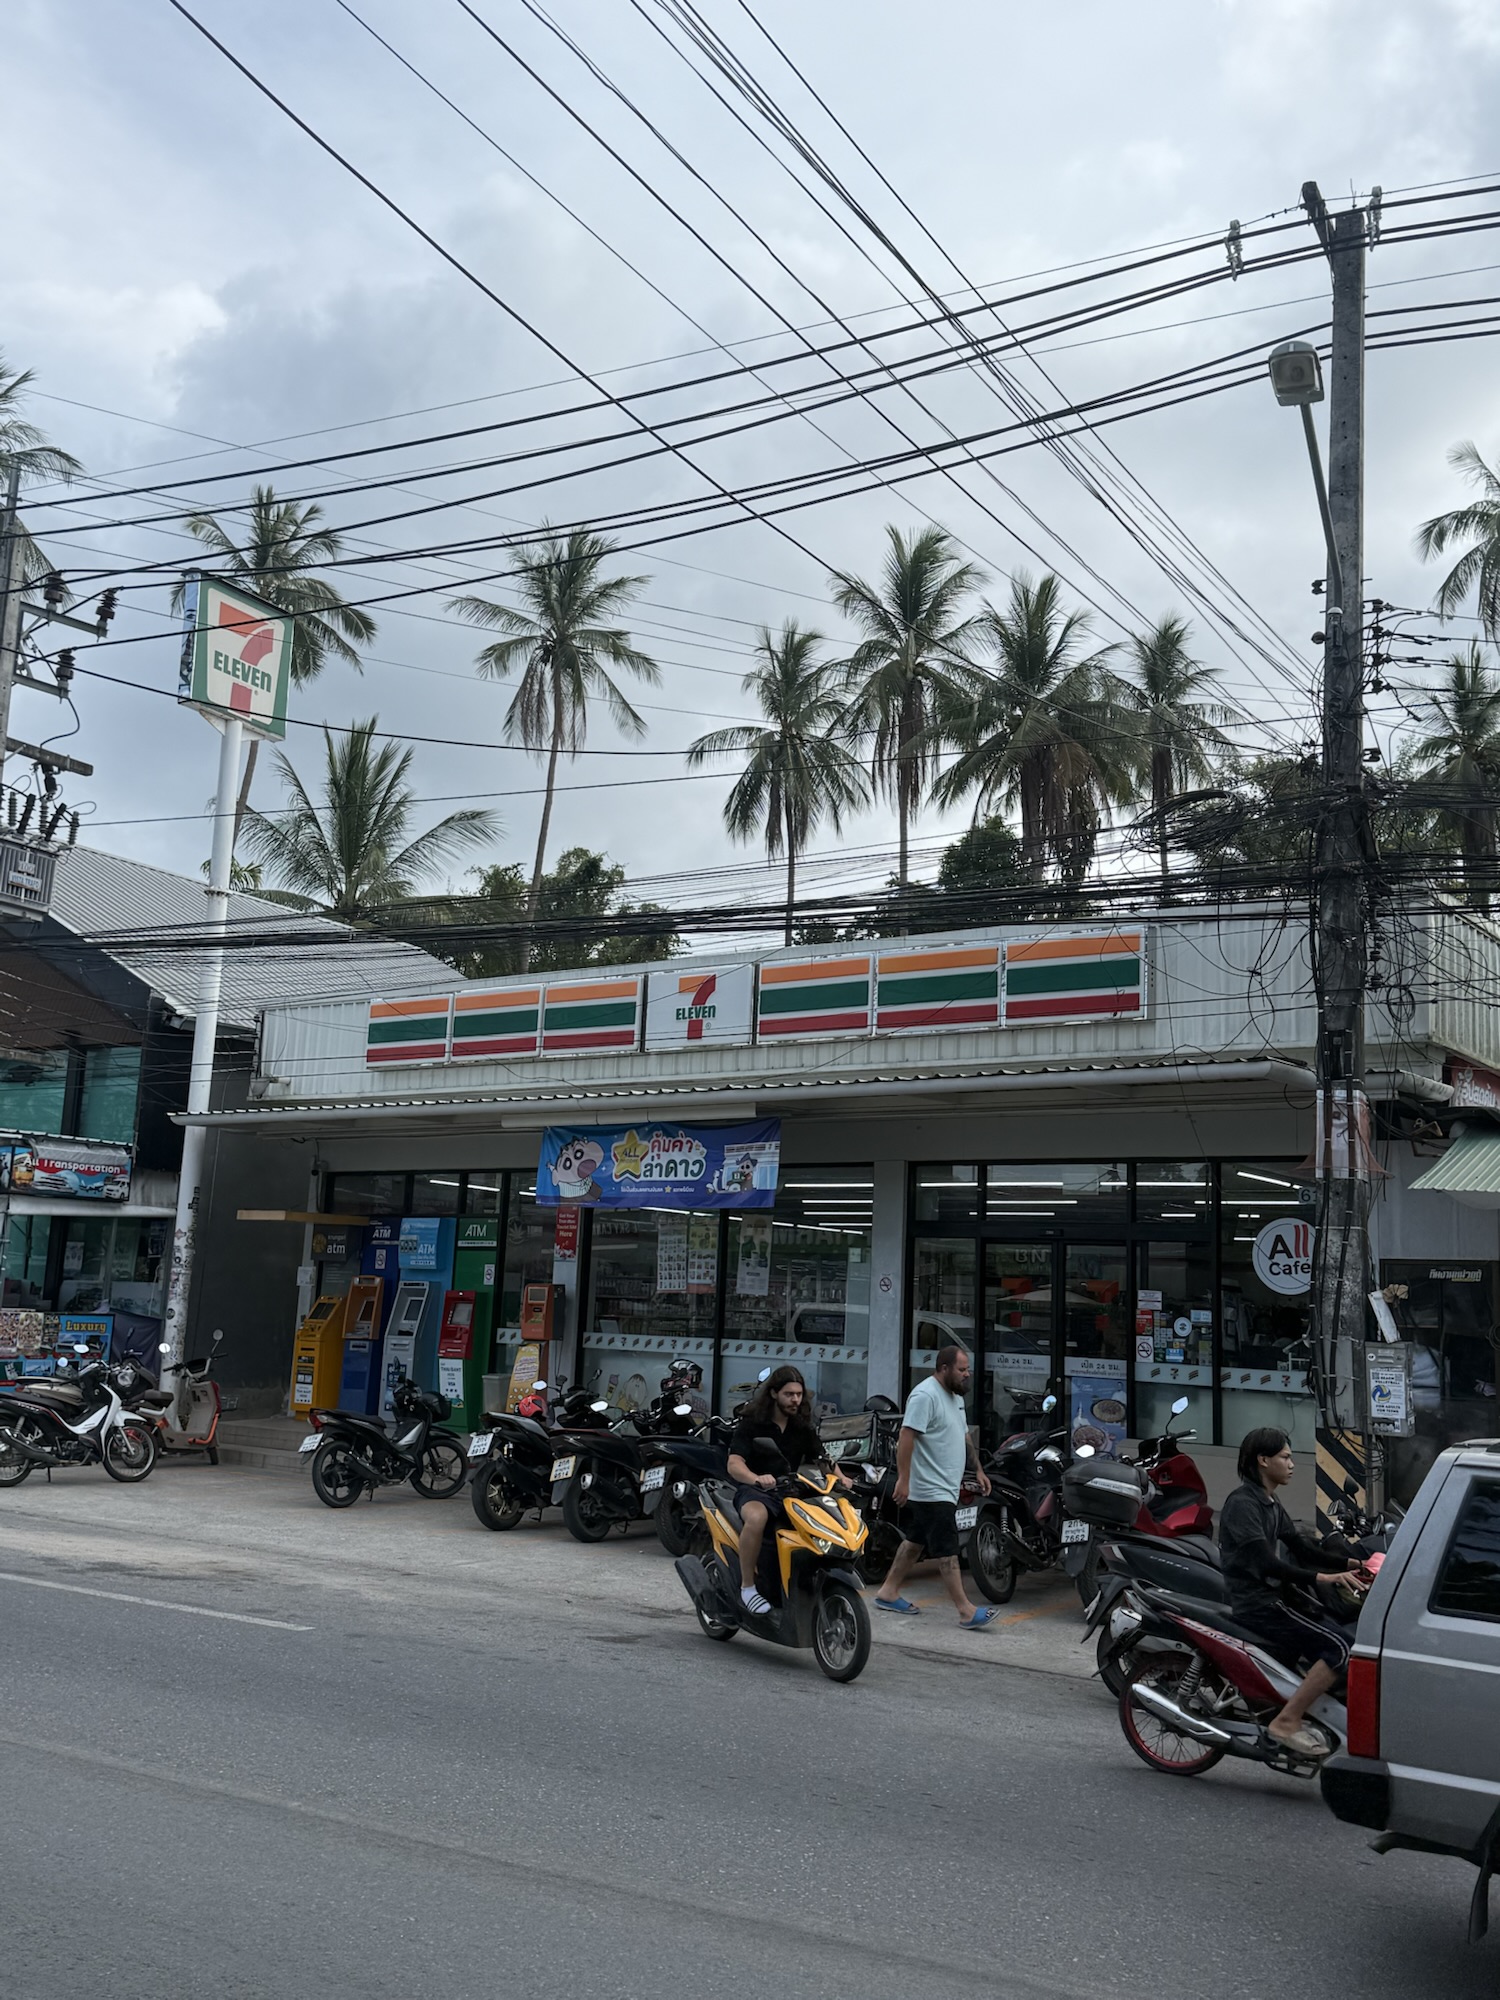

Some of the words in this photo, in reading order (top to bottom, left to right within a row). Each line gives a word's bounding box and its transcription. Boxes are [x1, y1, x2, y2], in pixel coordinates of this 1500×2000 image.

[642, 1155, 705, 1178] ล่าดาว
[372, 1229, 392, 1239] ATM
[464, 1224, 488, 1237] ATM
[326, 1243, 346, 1254] atm
[1269, 1224, 1309, 1260] All
[417, 1243, 436, 1255] ATM
[1269, 1258, 1312, 1276] Café
[66, 1320, 106, 1334] Luxury
